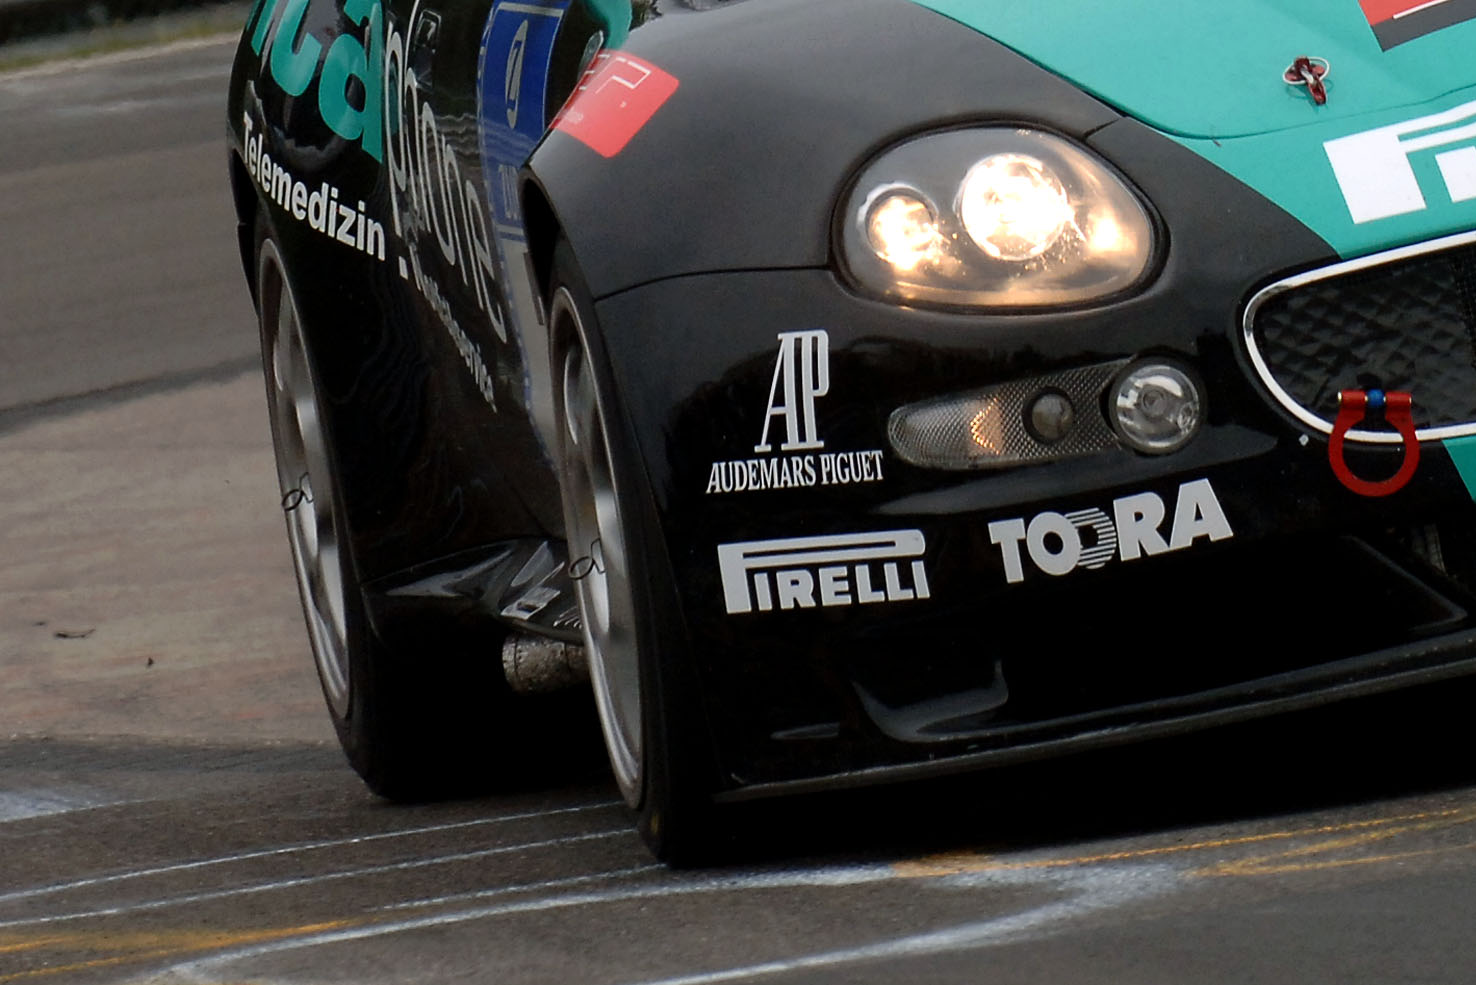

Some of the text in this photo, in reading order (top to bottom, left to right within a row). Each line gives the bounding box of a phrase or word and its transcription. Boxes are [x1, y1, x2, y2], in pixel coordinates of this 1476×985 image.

[242, 111, 387, 262] Telemedizin
[754, 329, 829, 454] AP
[705, 449, 884, 494] AUDEMARS PIGUET
[716, 528, 932, 615] PIRELLI
[988, 477, 1234, 585] TOORA
